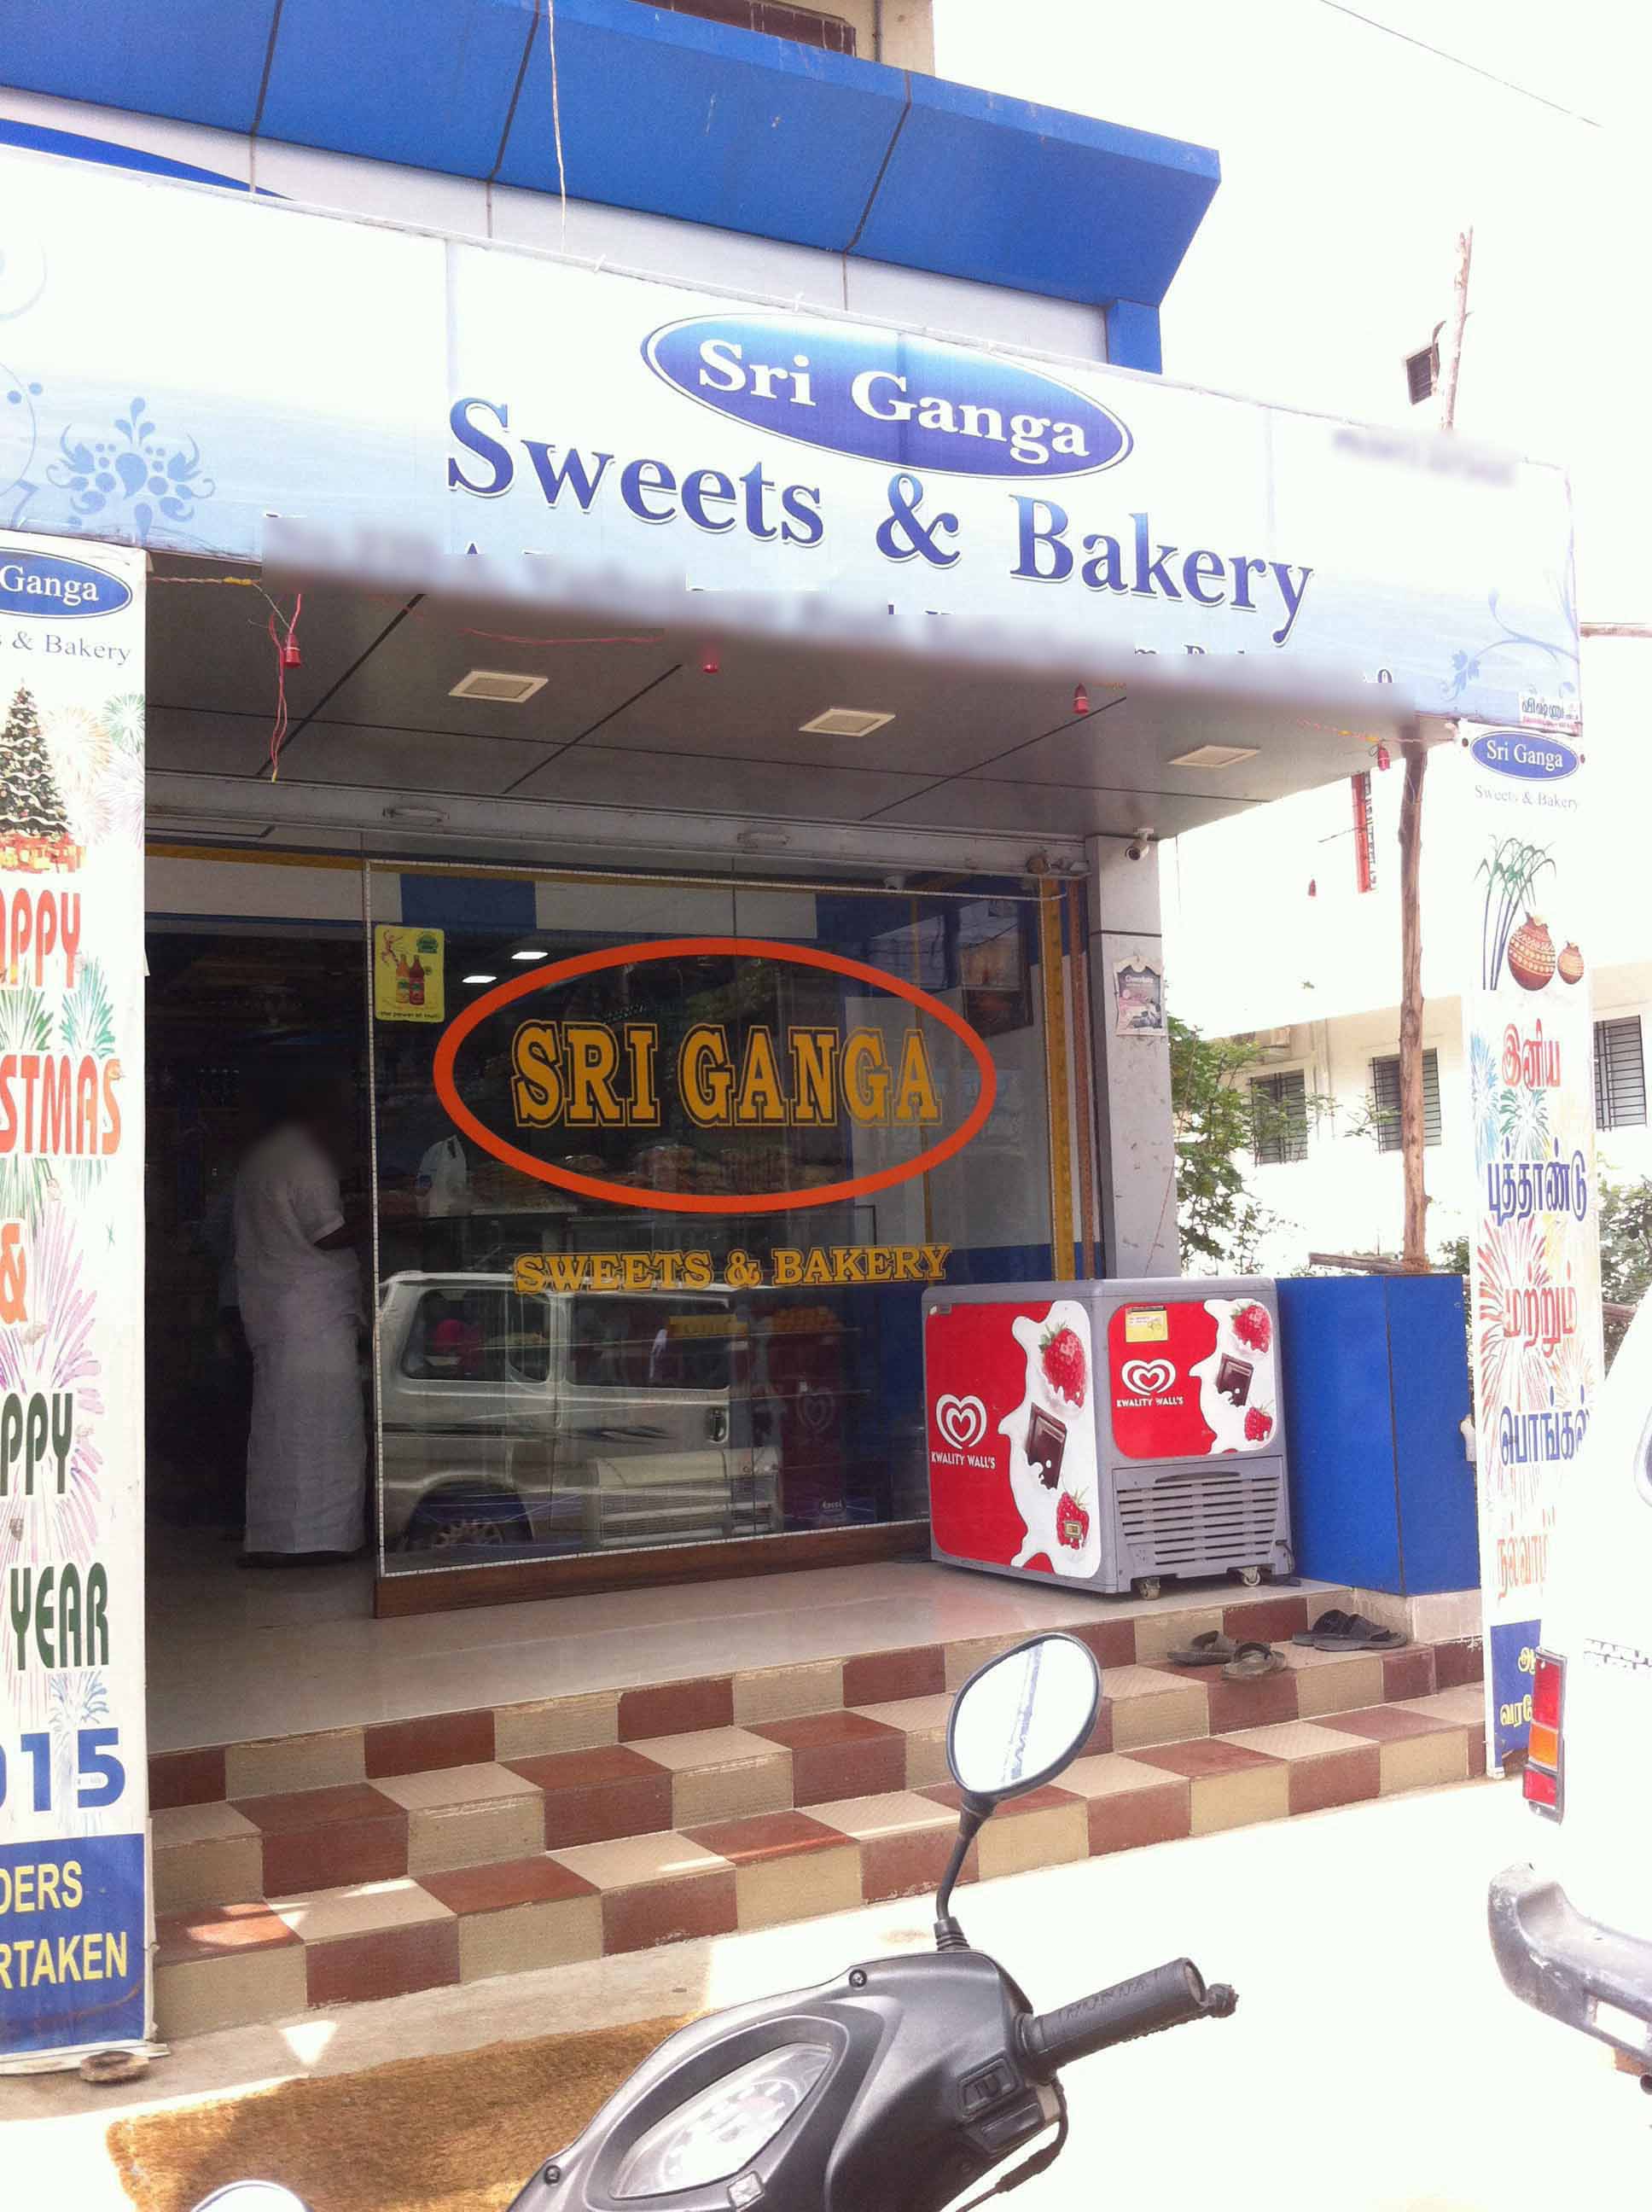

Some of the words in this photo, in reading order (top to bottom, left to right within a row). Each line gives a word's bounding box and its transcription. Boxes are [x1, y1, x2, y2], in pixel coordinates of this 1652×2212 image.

[698, 339, 817, 406] Sri
[852, 370, 1091, 464] Ganga
[448, 397, 824, 548] Sweets
[875, 473, 961, 568] &
[1009, 493, 1314, 646] Bakery
[0, 565, 99, 607] Ganga
[12, 631, 32, 650] &
[45, 634, 131, 666] Bakery
[1486, 740, 1509, 761] Sri
[1514, 743, 1563, 772] Ganga
[1538, 792, 1579, 812] Bakery
[0, 888, 81, 988] PPY
[512, 1019, 660, 1128] SRI
[678, 1023, 942, 1128] GANGA
[1502, 1017, 1562, 1090] இனிய
[1486, 1137, 1587, 1226] புத்தாண்டு
[514, 1249, 714, 1294] SWEETS
[724, 1249, 762, 1289] &
[771, 1243, 951, 1286] BAKERY
[1503, 1260, 1579, 1359] மற்றும்
[1116, 1398, 1153, 1407] KWALITY
[1155, 1395, 1184, 1406] WALL'S
[931, 1451, 965, 1465] KWALITY
[967, 1454, 996, 1470] WALL'S
[10, 1562, 109, 1670] YEAR
[0, 1727, 125, 1813] 15
